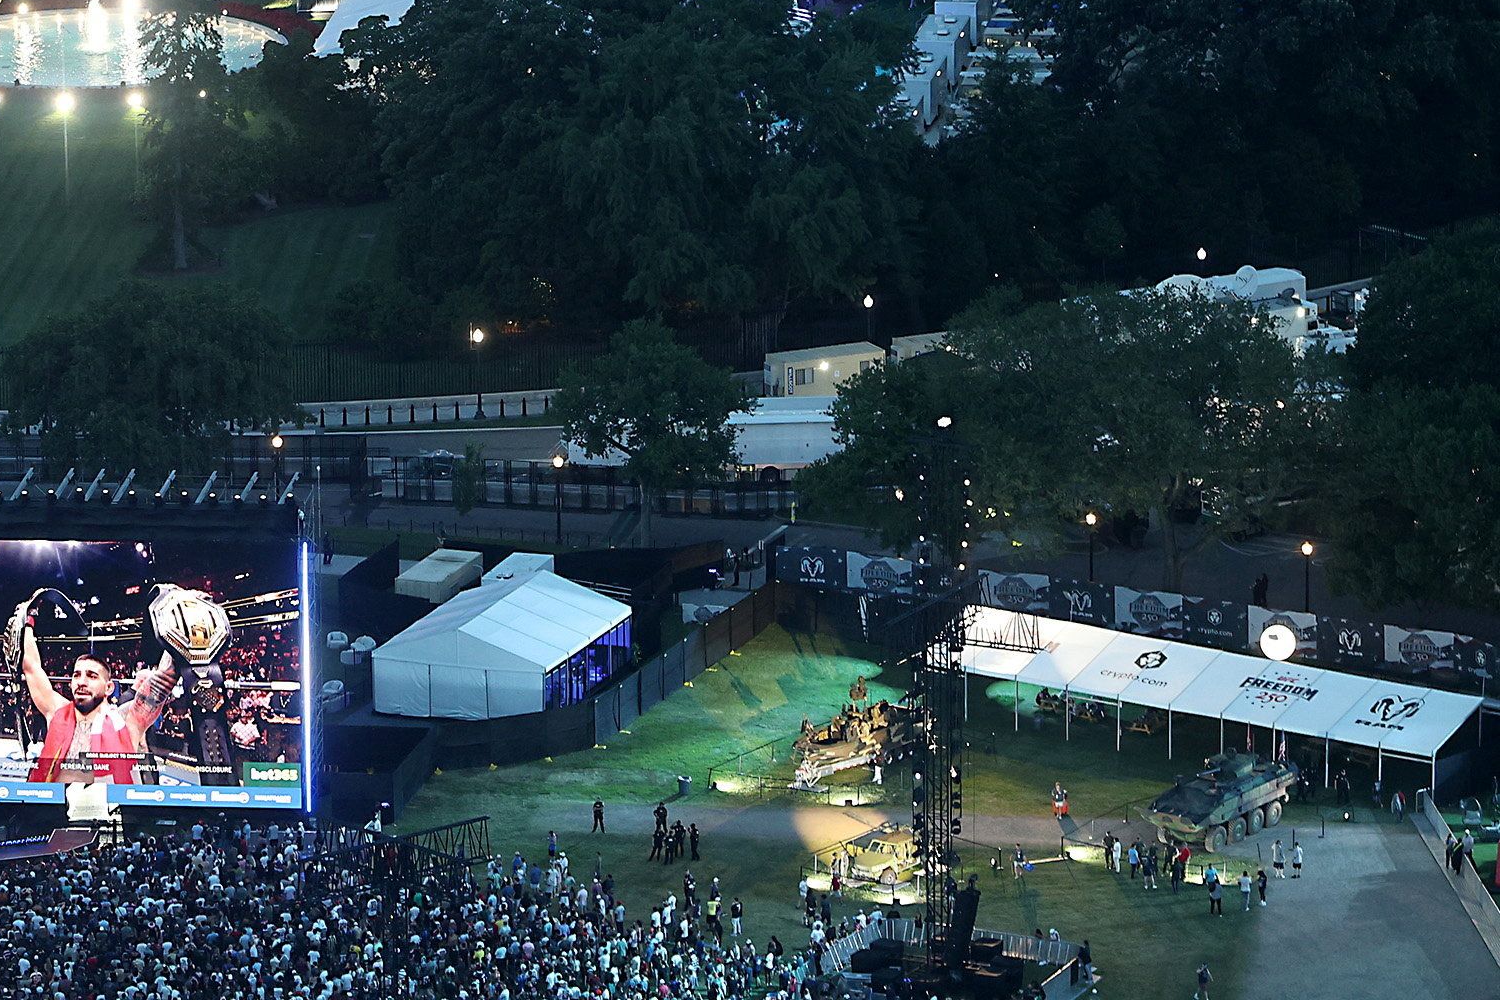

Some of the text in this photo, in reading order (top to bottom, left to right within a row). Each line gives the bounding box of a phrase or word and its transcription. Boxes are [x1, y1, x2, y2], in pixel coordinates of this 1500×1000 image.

[872, 579, 889, 587] 250
[1008, 595, 1024, 603] 250
[1141, 613, 1158, 622] 250
[1197, 628, 1233, 637] crypto.com
[1411, 652, 1429, 661] 250
[1100, 668, 1168, 687] crypto.com
[1239, 676, 1320, 702] FREEDOM
[1255, 691, 1288, 703] 250
[1355, 718, 1404, 731] RAM
[94, 763, 110, 771] GANE
[250, 768, 298, 781] bet365
